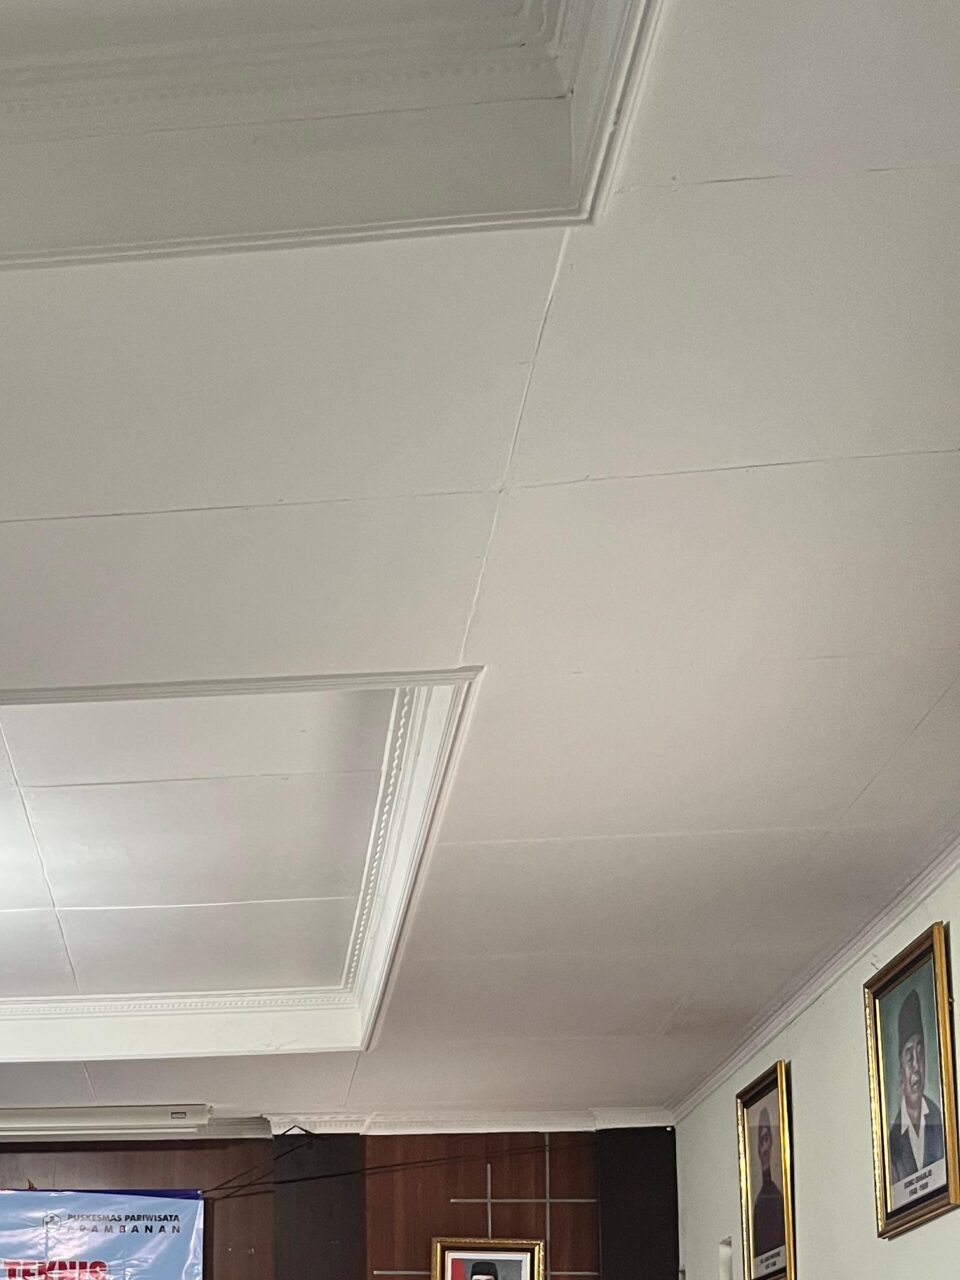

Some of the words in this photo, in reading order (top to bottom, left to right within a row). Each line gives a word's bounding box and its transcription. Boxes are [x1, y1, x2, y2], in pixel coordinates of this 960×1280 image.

[67, 1214, 122, 1222] PUSKESMAS
[124, 1214, 180, 1222] PARIWISATA
[67, 1225, 181, 1234] PRAMBANAN
